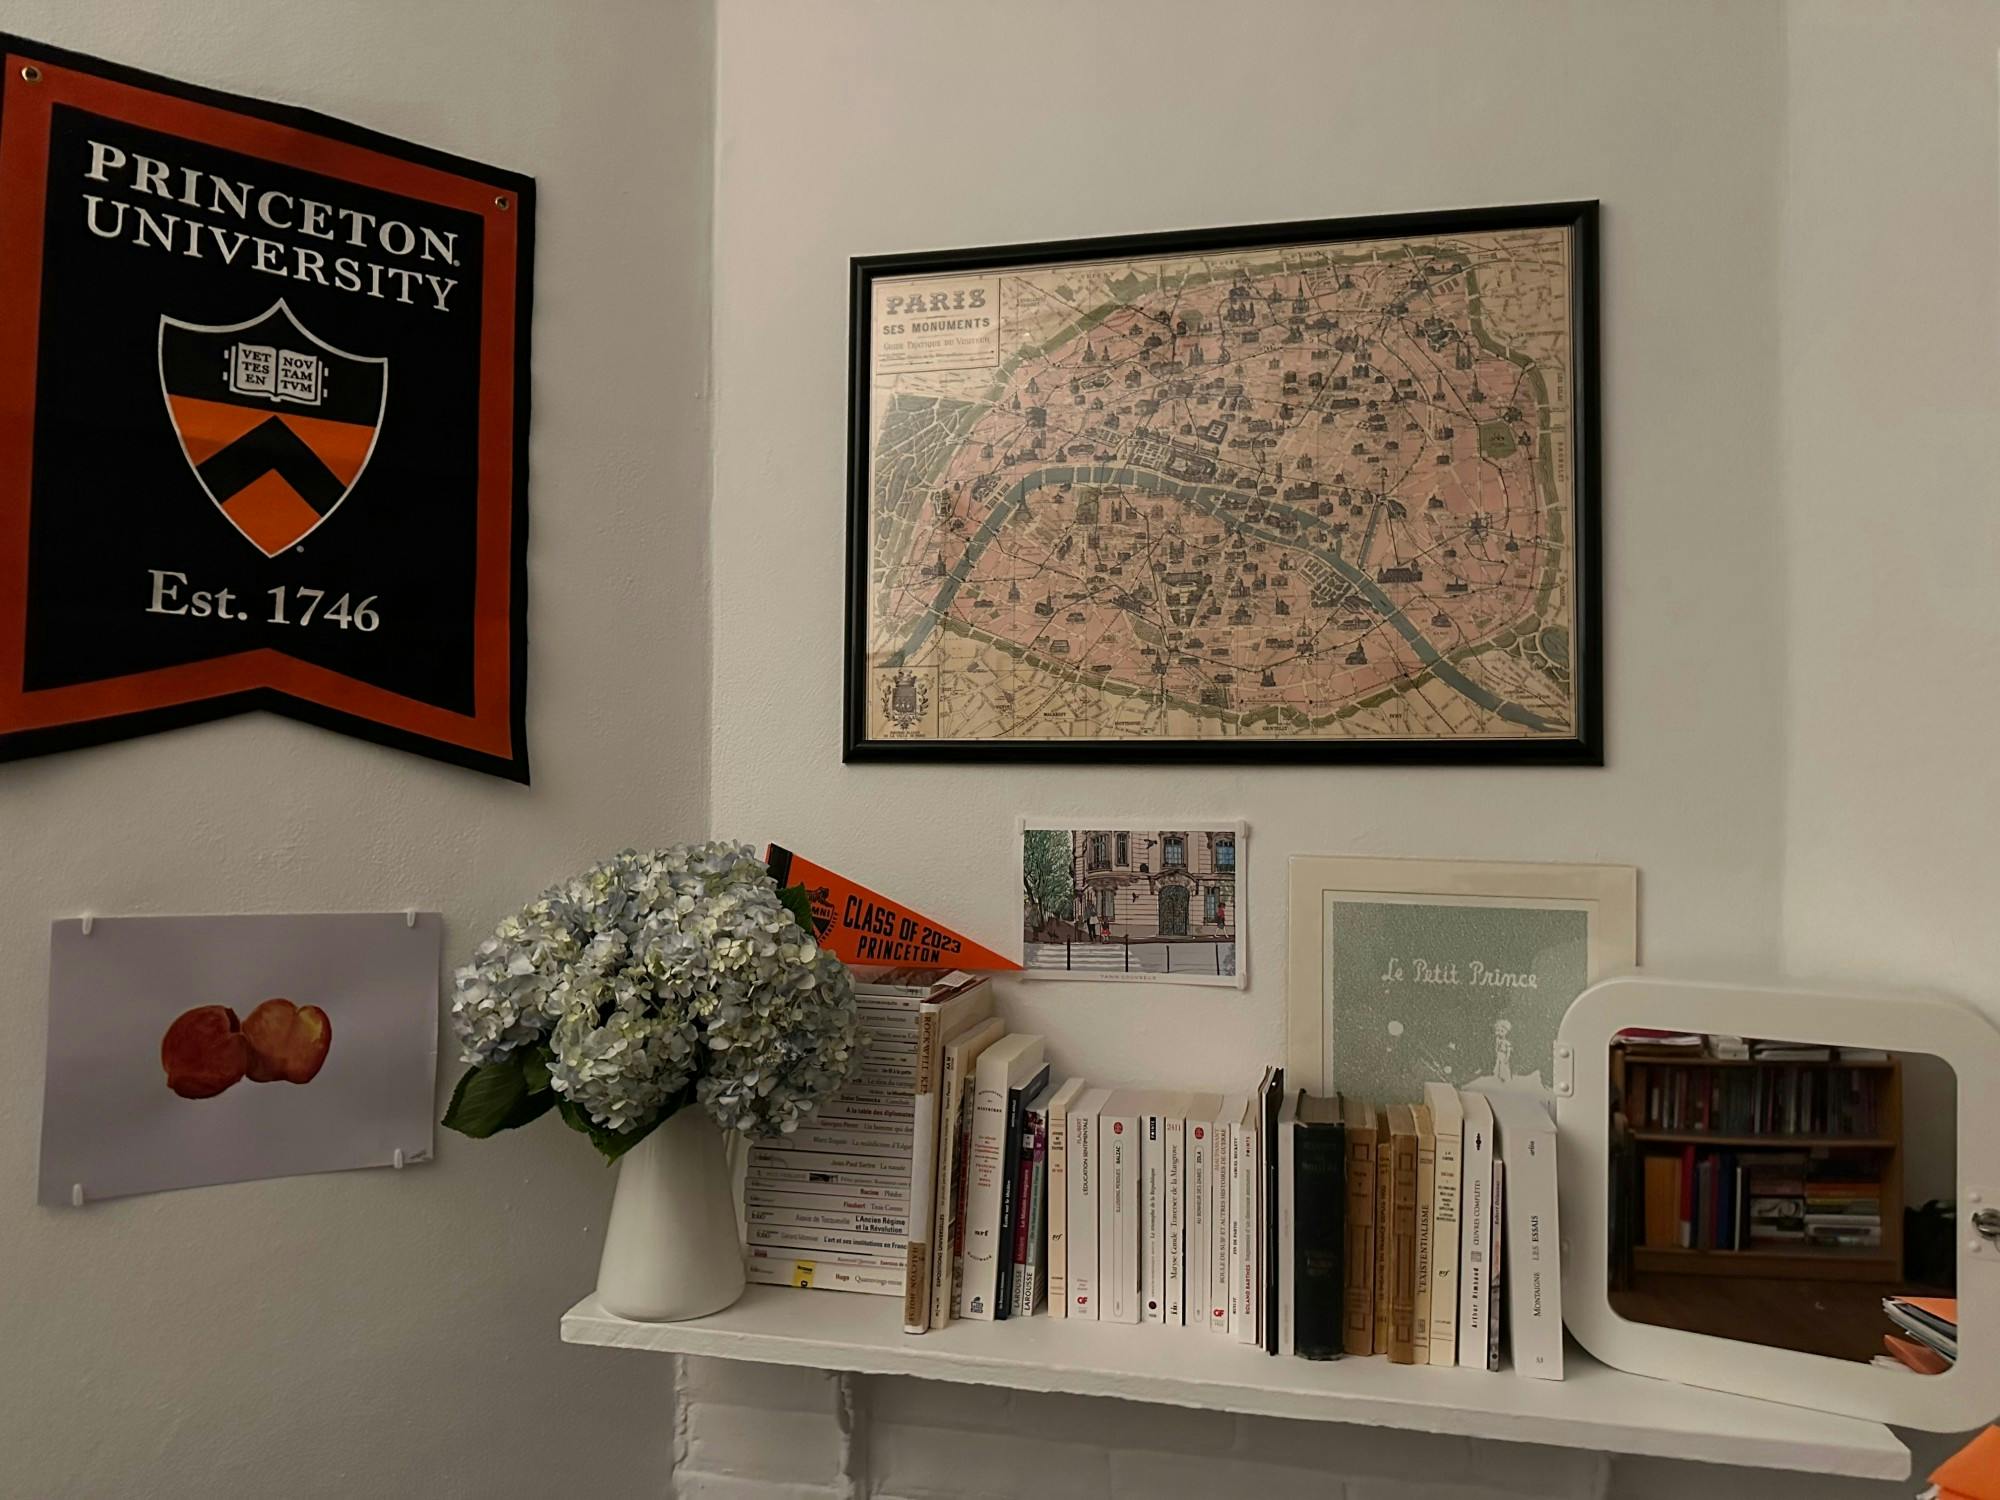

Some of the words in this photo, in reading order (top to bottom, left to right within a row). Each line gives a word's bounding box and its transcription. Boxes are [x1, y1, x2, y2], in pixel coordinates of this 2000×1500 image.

[83, 140, 459, 267] PRINCETON
[82, 194, 459, 313] UNIVERSITY
[886, 288, 988, 316] PARIS
[883, 324, 905, 336] SES
[911, 317, 992, 333] MONUMENTS
[241, 348, 273, 364] VET
[283, 356, 314, 371] NOV
[241, 361, 270, 375] TES
[280, 367, 313, 383] TAM
[245, 374, 267, 386] EN
[280, 379, 313, 394] TVM
[145, 568, 248, 621] Est.
[266, 586, 381, 633] 1746
[810, 906, 831, 918] MNI
[843, 894, 897, 938] CLASS
[899, 916, 921, 943] OF
[920, 926, 962, 954] 2023
[856, 934, 941, 964] PRINCETON
[1381, 957, 1405, 983] Le
[1411, 957, 1460, 985] Petit
[1468, 960, 1538, 989] Prince
[921, 1016, 932, 1072] ROCKWELL
[919, 1077, 930, 1094] KE
[1170, 1144, 1180, 1178] Mangrove
[1220, 1156, 1226, 1165] DE
[1081, 1159, 1089, 1196] L'ÉDUCATION
[1170, 1186, 1178, 1196] de
[855, 1214, 881, 1224] L'Ancien
[882, 1216, 906, 1227] Régime
[870, 1225, 903, 1234] Révolution
[1219, 1227, 1226, 1236] ET
[1530, 1214, 1539, 1242] ESSAIS
[892, 1241, 907, 1250] Franc
[1219, 1251, 1226, 1262] DE
[1417, 1204, 1430, 1294] L'EXISTENTIALISME
[1531, 1245, 1540, 1261] LES
[836, 1273, 850, 1282] Hugo
[910, 1247, 919, 1288] HALCYON
[1170, 1255, 1179, 1280] Maryse
[1013, 1271, 1022, 1308] LAROUSSE
[1024, 1272, 1033, 1311] LAROUSSE
[1472, 1267, 1480, 1299] Rimbaud
[1532, 1272, 1542, 1317] MONTAIGNE
